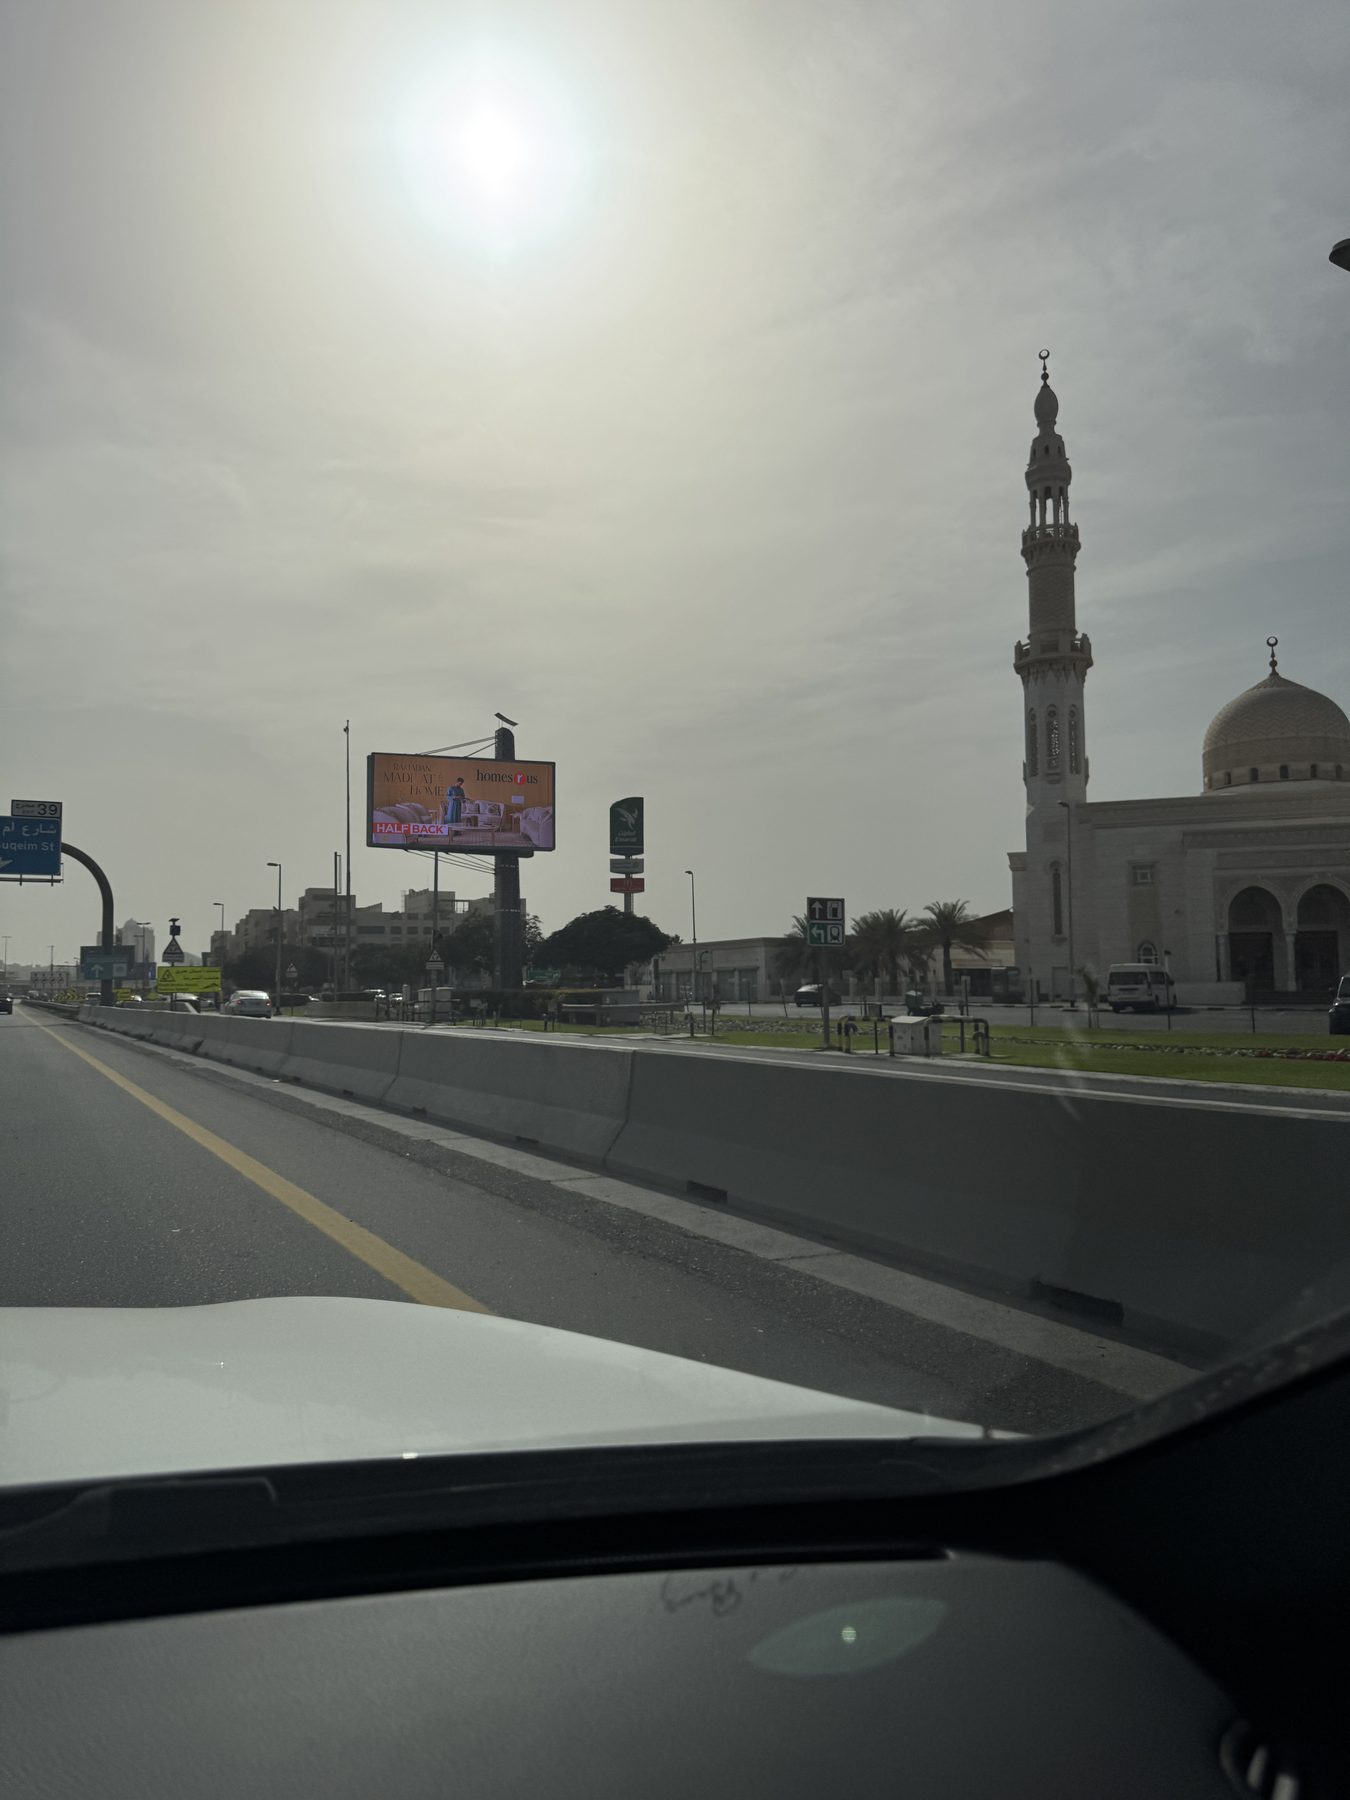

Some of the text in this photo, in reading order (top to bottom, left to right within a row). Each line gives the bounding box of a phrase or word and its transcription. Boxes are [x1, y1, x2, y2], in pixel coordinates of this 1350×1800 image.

[476, 769, 513, 783] homes
[526, 775, 538, 784] us
[37, 803, 57, 815] 39
[22, 824, 56, 836] شارع
[376, 823, 409, 833] HALF
[41, 842, 54, 851] St
